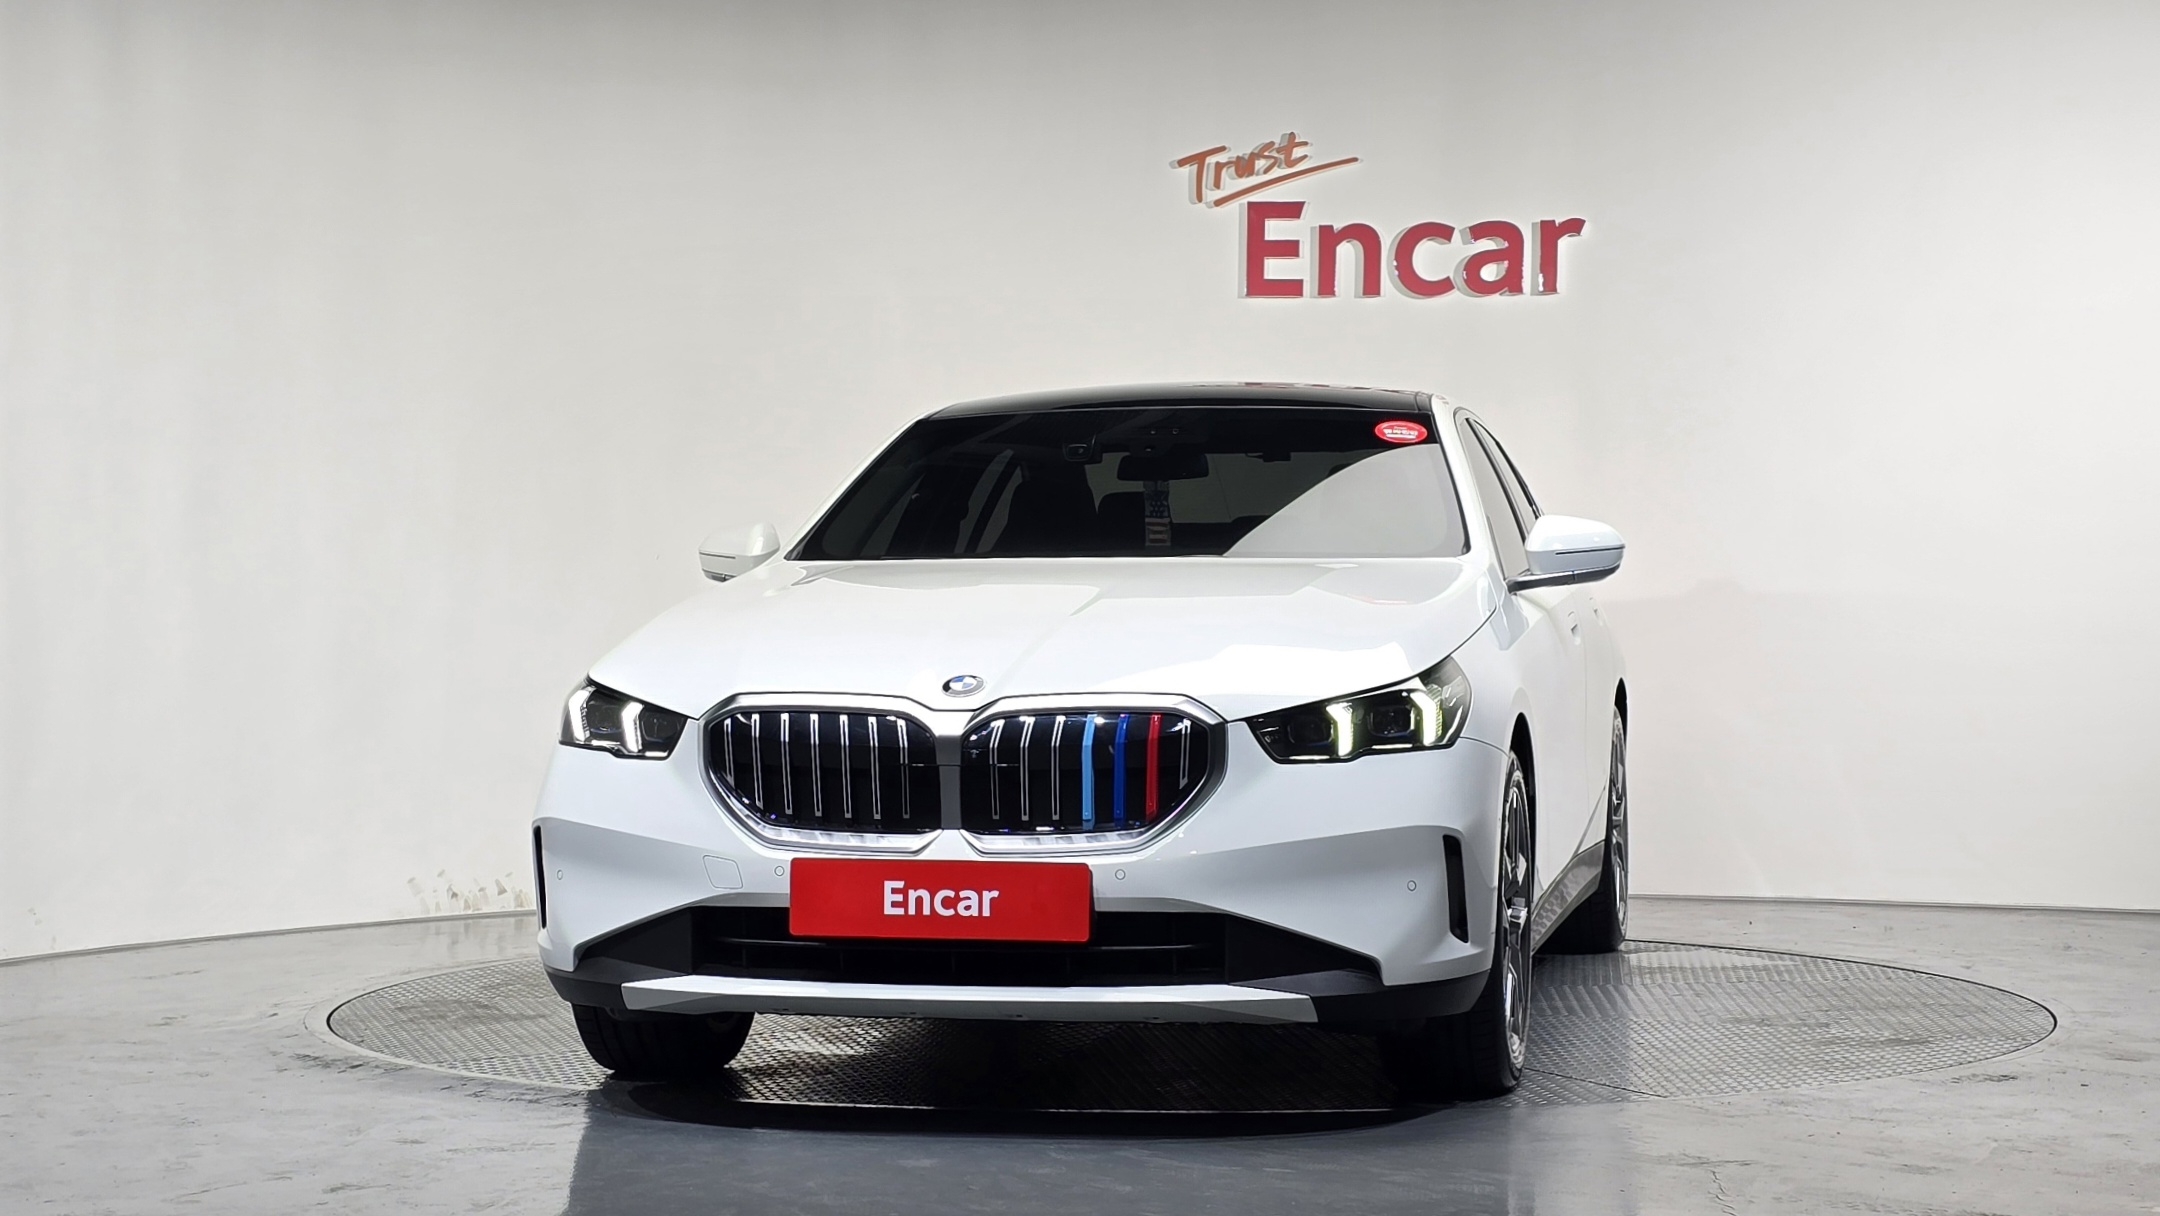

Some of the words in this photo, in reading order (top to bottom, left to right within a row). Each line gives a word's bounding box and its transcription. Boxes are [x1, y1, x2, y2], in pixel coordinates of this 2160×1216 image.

[1175, 131, 1310, 204] Trust
[1244, 200, 1587, 297] Encar
[883, 880, 1000, 917] Encar
